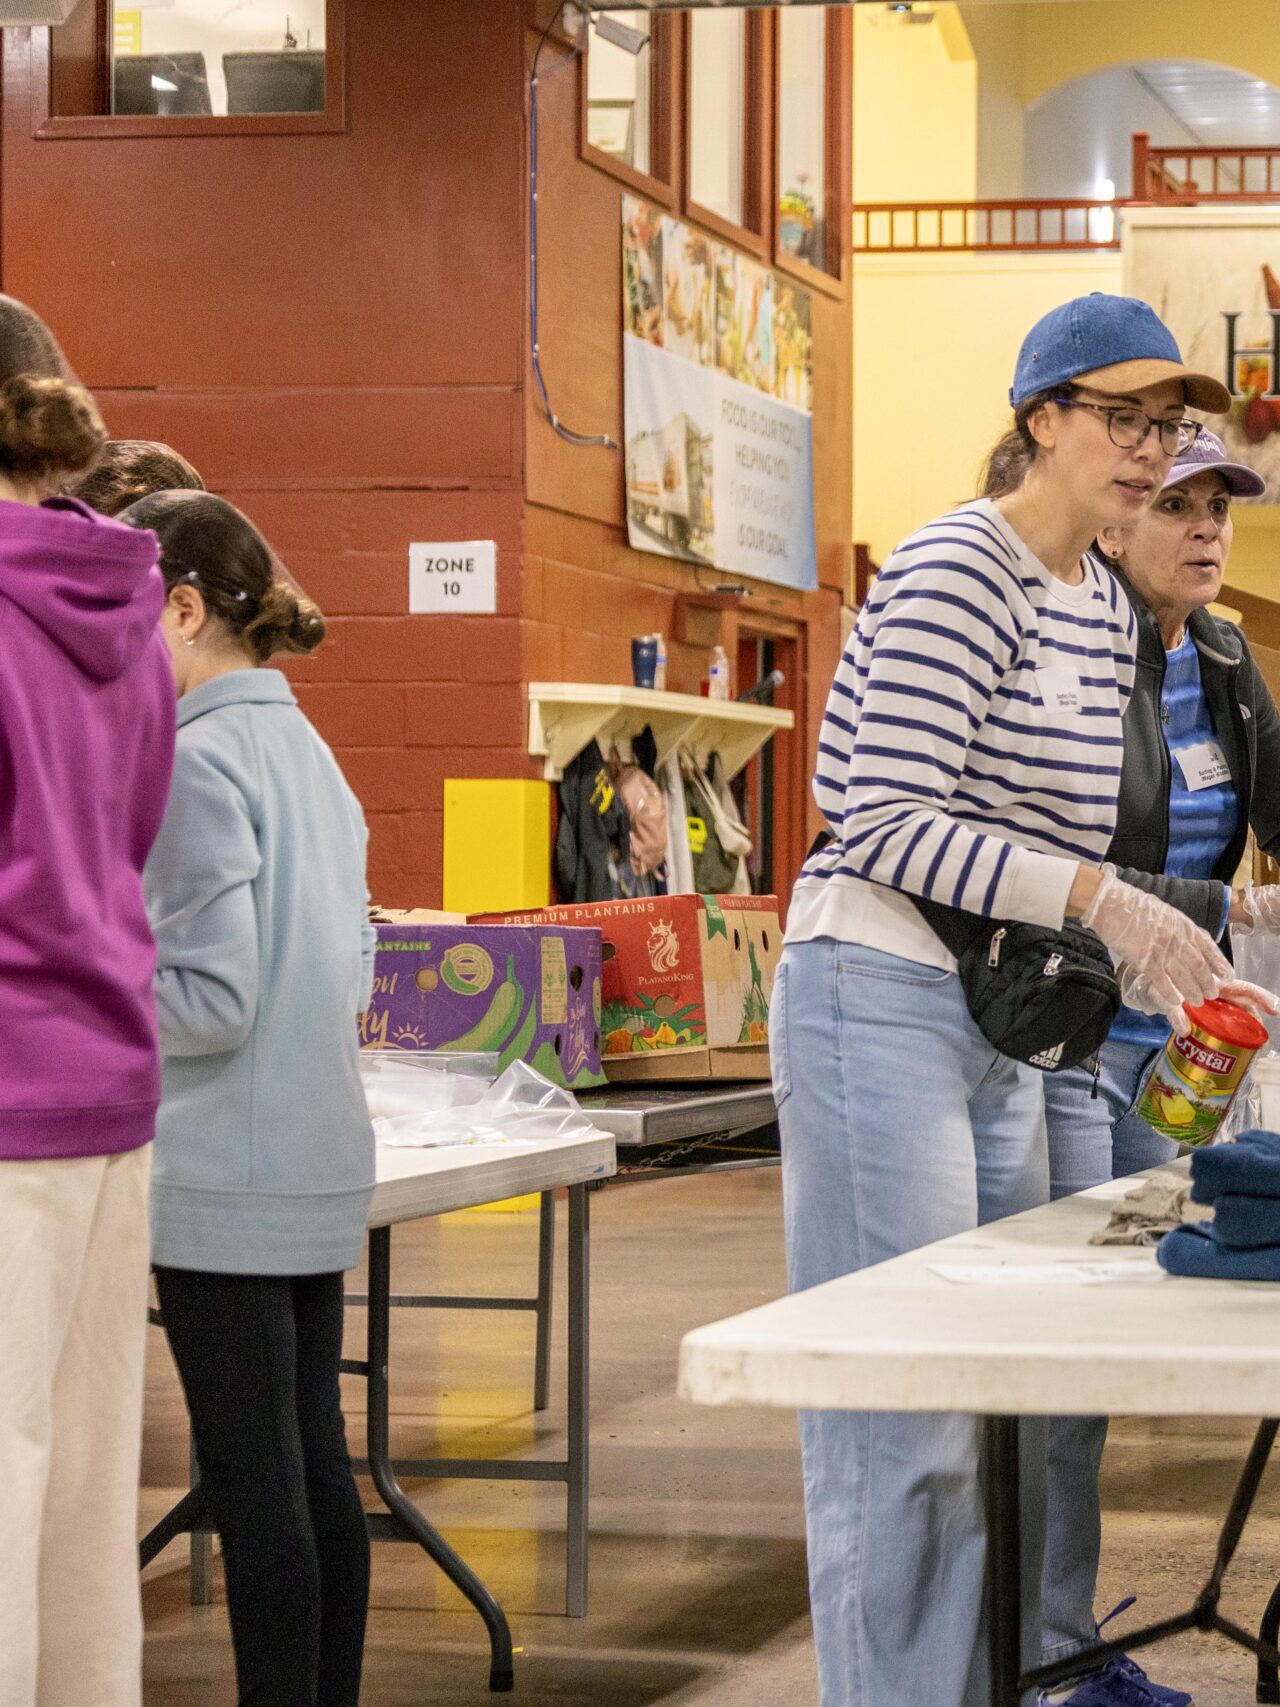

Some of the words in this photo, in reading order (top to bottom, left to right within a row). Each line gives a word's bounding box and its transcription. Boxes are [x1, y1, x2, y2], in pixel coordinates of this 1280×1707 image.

[425, 558, 474, 572] ZONE
[443, 582, 461, 596] 10
[504, 911, 568, 925] PREMIUM
[574, 902, 656, 919] PLANTAINS
[1029, 1054, 1059, 1069] adidas
